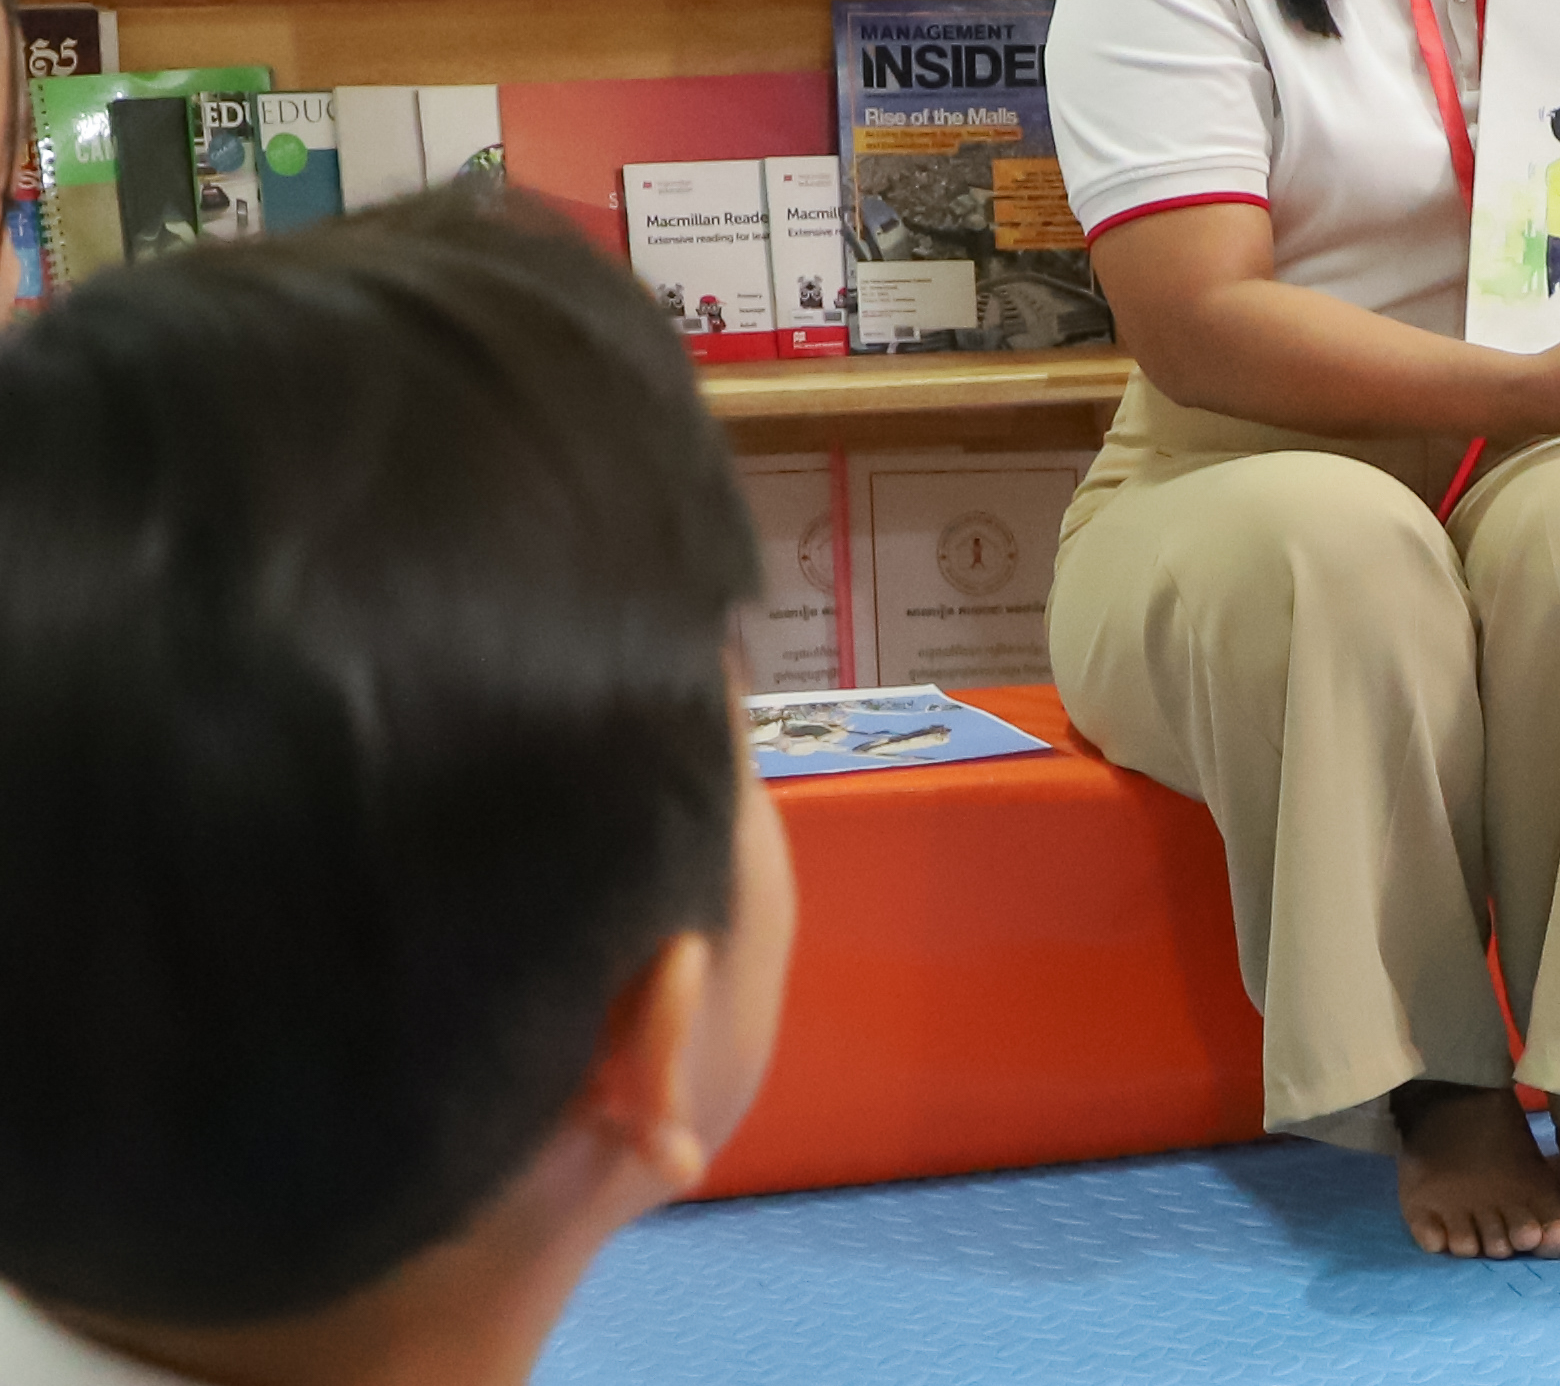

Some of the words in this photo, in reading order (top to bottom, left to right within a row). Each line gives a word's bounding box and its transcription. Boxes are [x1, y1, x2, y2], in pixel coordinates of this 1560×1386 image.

[860, 24, 1016, 41] MANAGEMENT
[861, 44, 1047, 89] INSIDE
[864, 107, 907, 126] Rise
[911, 107, 931, 126] of
[934, 107, 963, 125] the
[967, 108, 1018, 126] Malls
[646, 215, 720, 229] Macmillan
[647, 235, 694, 246] Extensive
[696, 234, 734, 244] reading
[736, 232, 751, 242] for
[788, 227, 831, 237] Extensive
